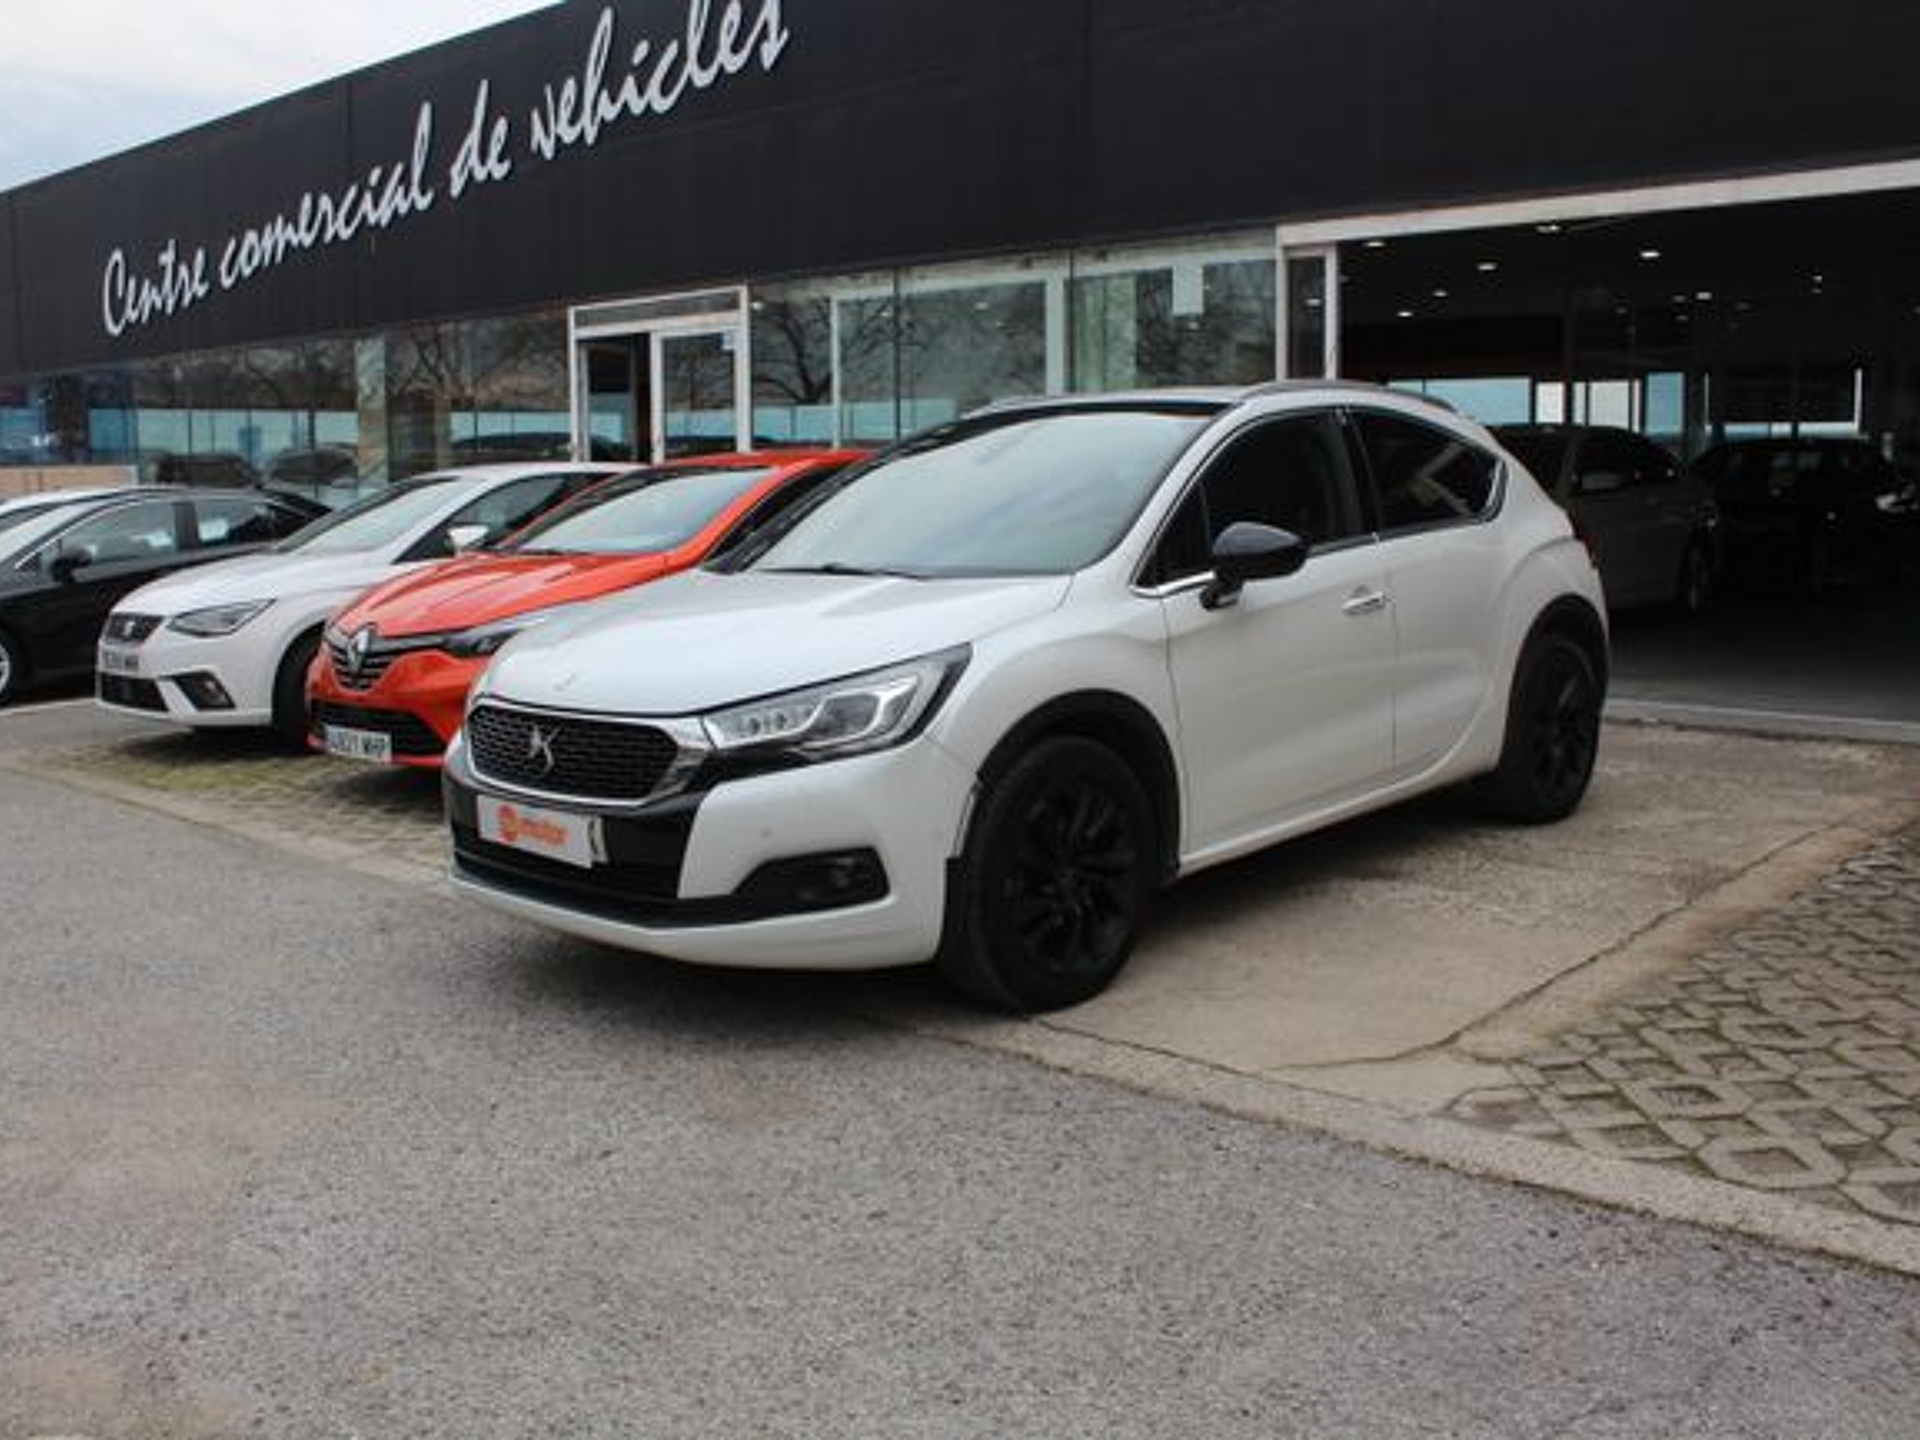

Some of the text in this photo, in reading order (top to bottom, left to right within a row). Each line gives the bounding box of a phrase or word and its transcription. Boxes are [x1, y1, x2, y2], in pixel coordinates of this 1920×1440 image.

[103, 0, 789, 336] Centre comercial de vehicles
